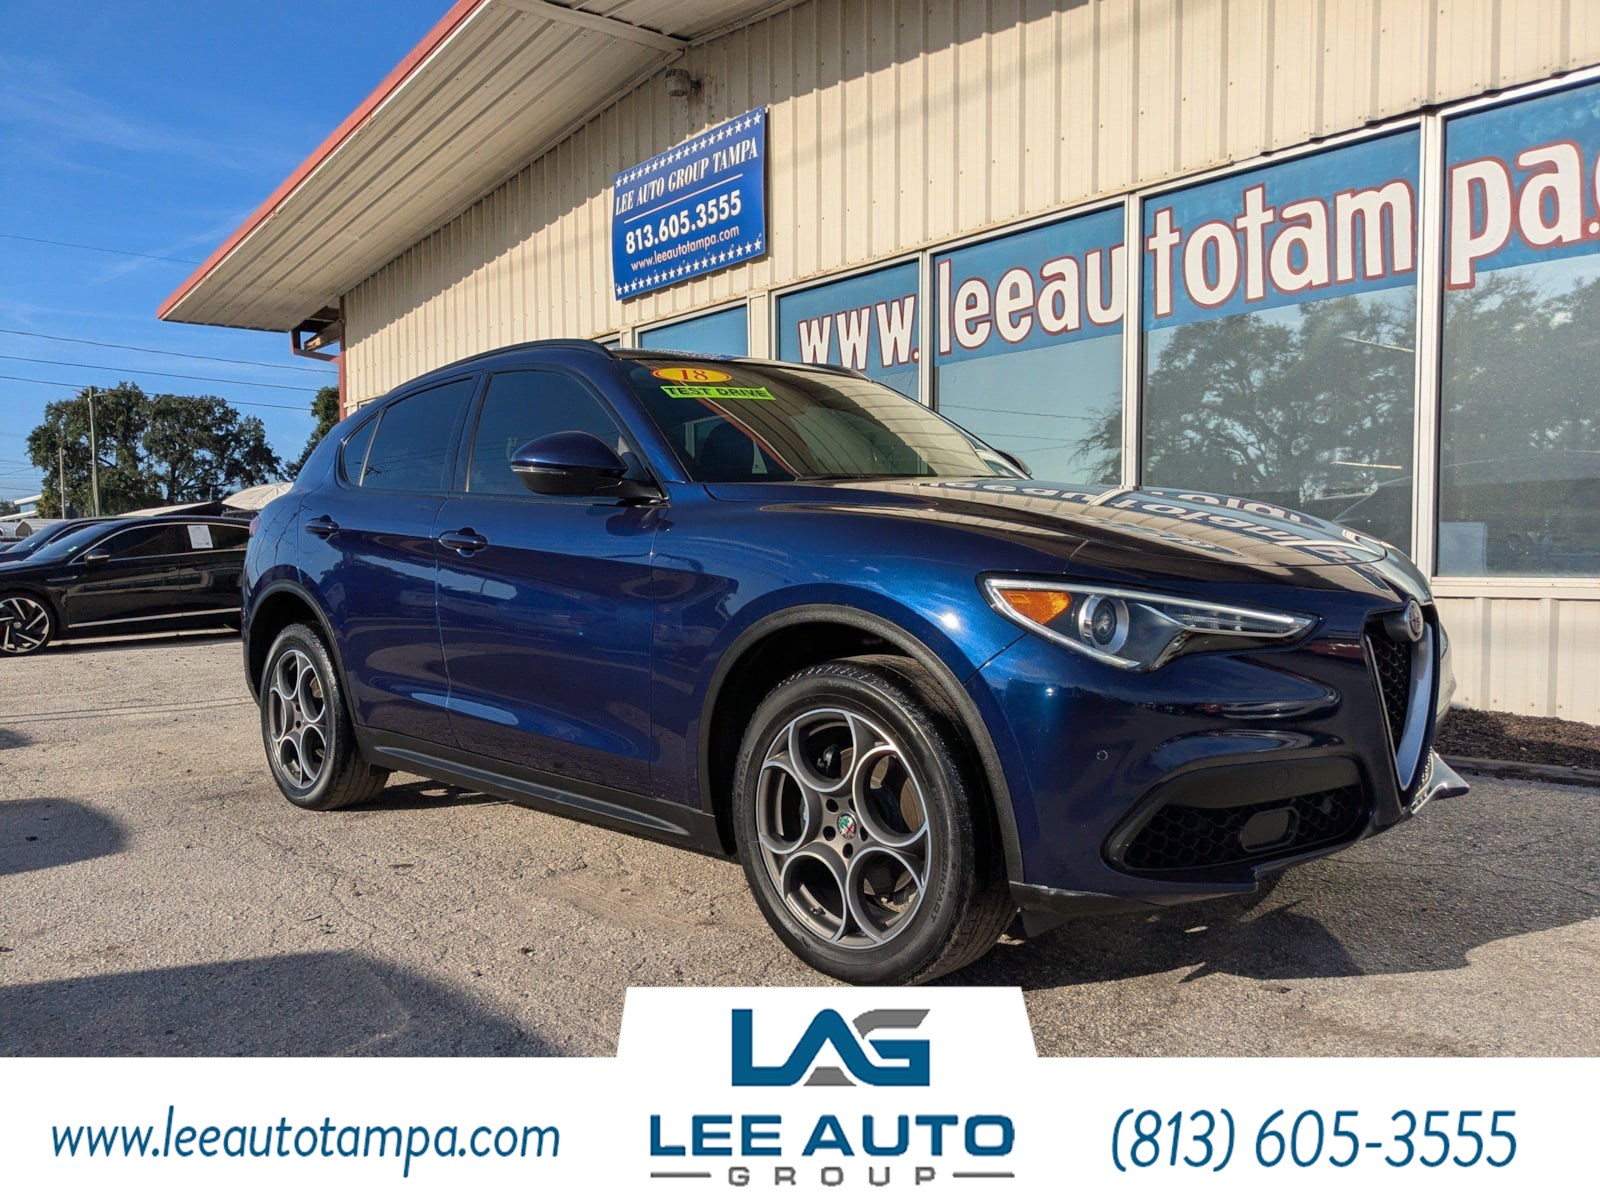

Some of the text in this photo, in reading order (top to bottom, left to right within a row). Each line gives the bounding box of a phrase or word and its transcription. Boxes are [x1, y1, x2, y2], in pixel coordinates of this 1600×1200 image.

[615, 137, 759, 216] LEE AUTO GROUP TAMPA
[625, 189, 742, 254] 813.605.3555
[630, 225, 740, 272] www.leeautotampa.com
[797, 140, 1600, 372] www.leeautotampa.
[664, 387, 771, 397] TEST DRIVE
